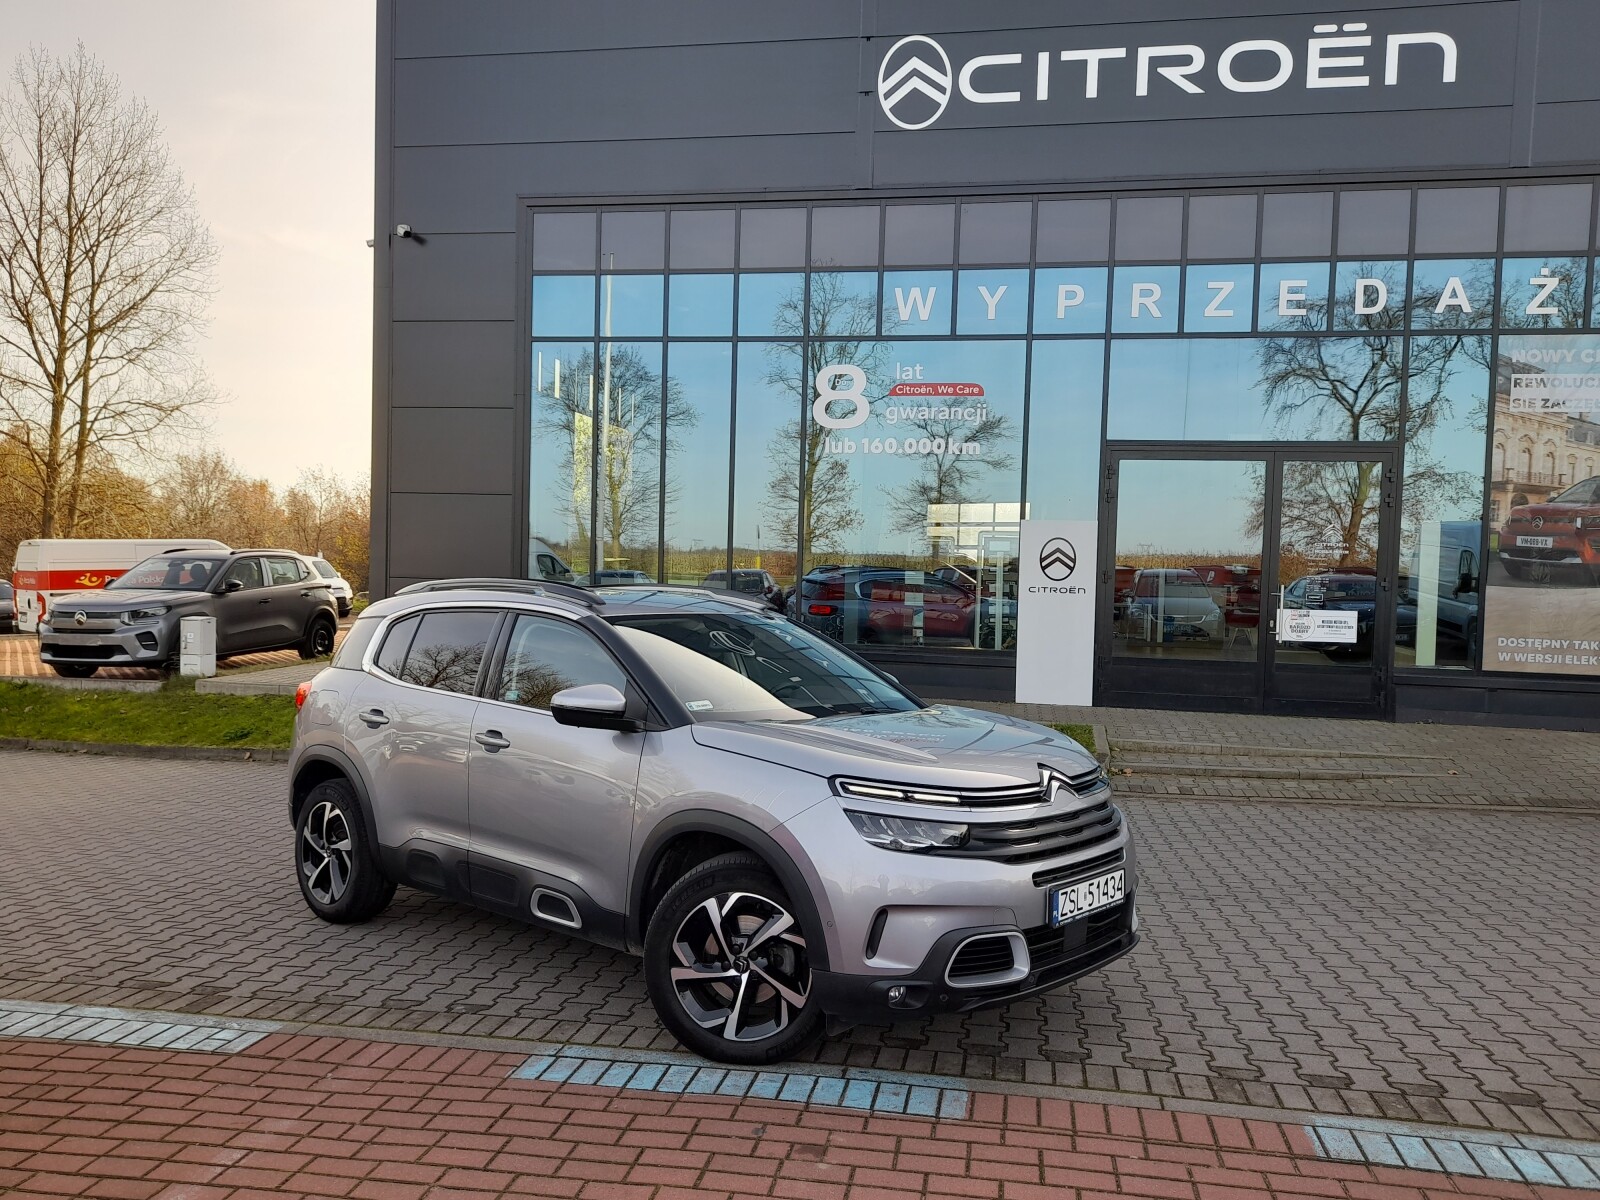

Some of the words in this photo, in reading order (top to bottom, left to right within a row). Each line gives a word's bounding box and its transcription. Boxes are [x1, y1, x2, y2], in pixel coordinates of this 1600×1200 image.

[958, 22, 1458, 104] CITROËN
[1511, 348, 1576, 363] NOWY
[895, 362, 924, 380] lat
[812, 364, 870, 429] 8
[895, 384, 935, 396] Citroën,
[937, 385, 954, 395] We
[955, 385, 980, 395] Care
[885, 403, 988, 425] gwarancji
[824, 438, 857, 455] lub
[1028, 585, 1086, 595] CITROËN
[1497, 637, 1570, 651] DOSTĘPNY
[1498, 651, 1512, 662] W
[1513, 652, 1562, 664] WERSJI
[1565, 654, 1600, 666] ELEK
[1060, 886, 1084, 918] ZSL
[1087, 872, 1123, 908] 51434
